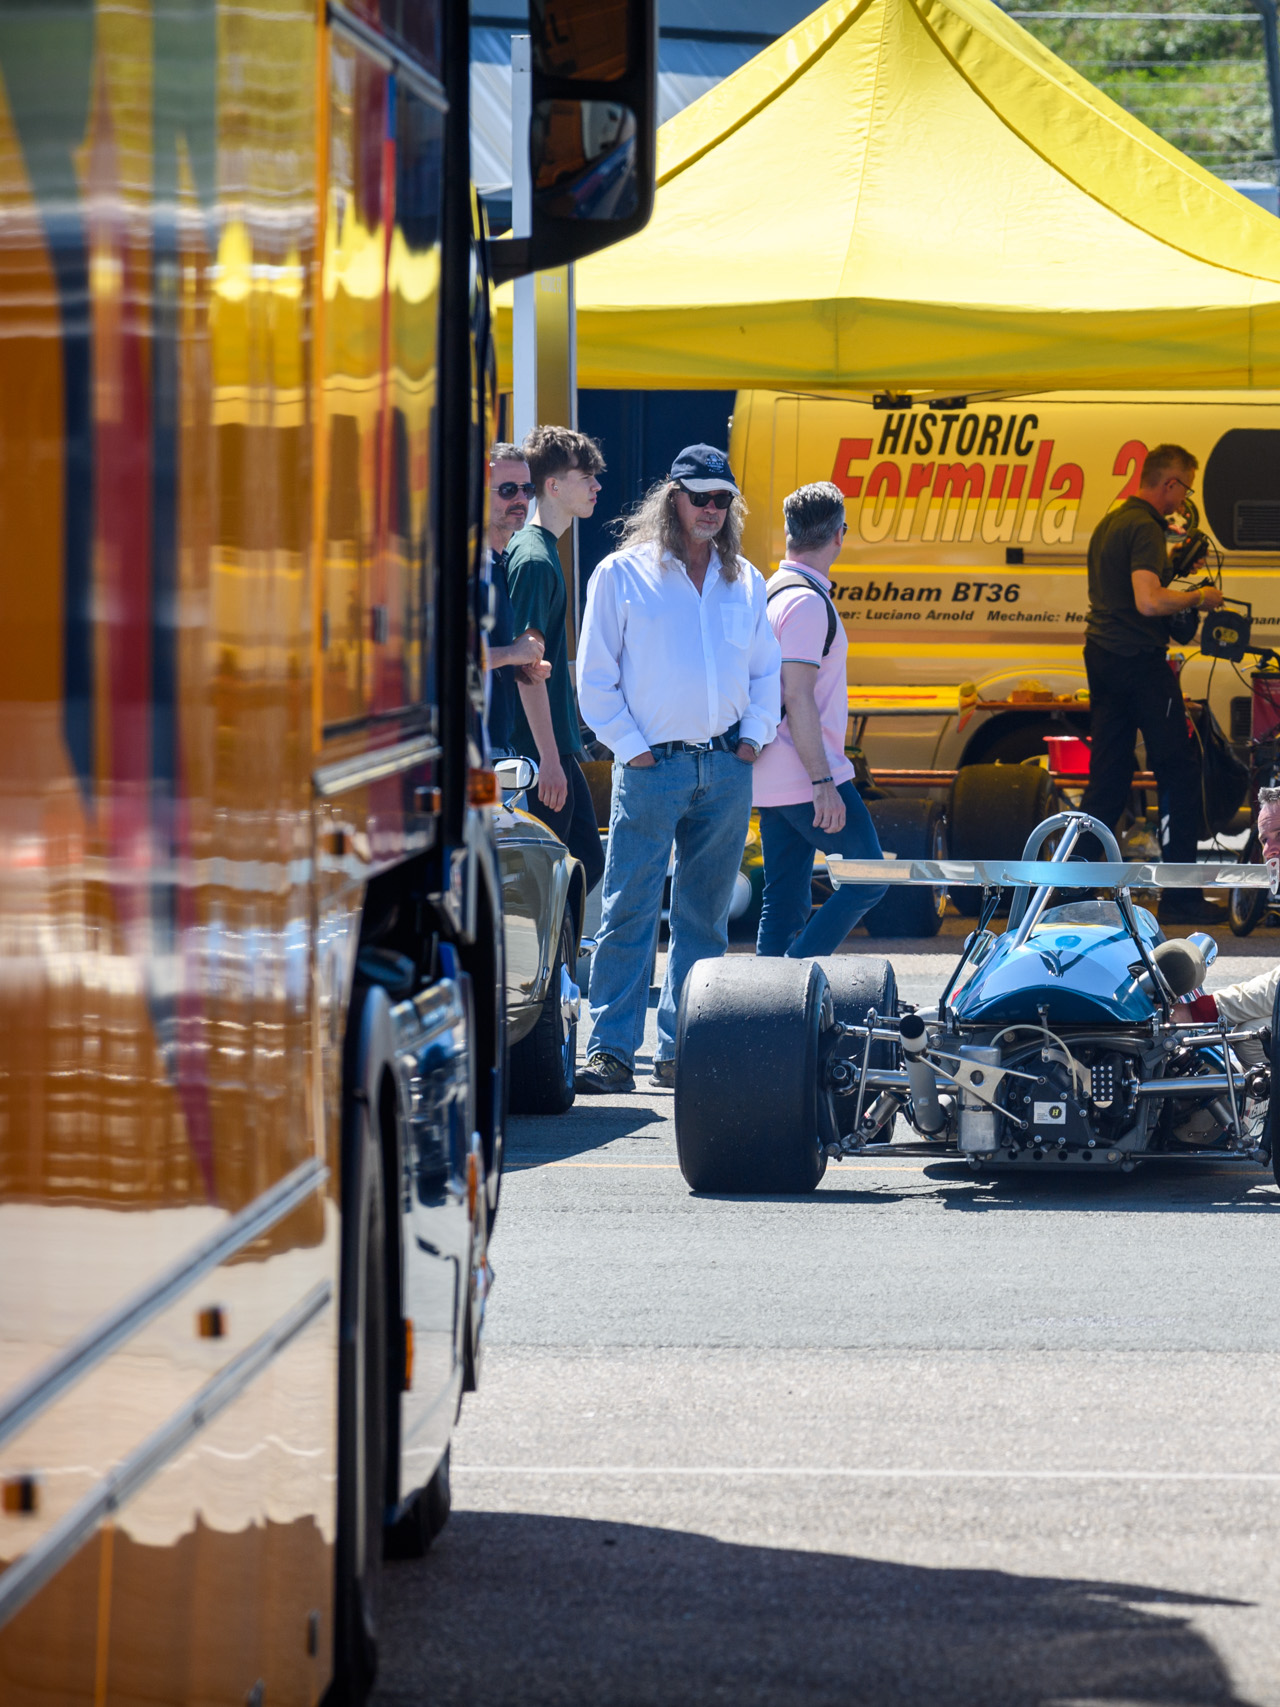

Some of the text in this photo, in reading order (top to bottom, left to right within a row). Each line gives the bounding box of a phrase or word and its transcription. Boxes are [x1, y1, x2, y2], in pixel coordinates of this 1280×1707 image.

[877, 413, 1038, 456] HISTORIC
[831, 438, 1084, 544] Formula
[951, 582, 1021, 603] BT36
[866, 609, 921, 620] Luciano
[925, 609, 975, 621] Arnold
[986, 611, 1061, 622] Mechanic:
